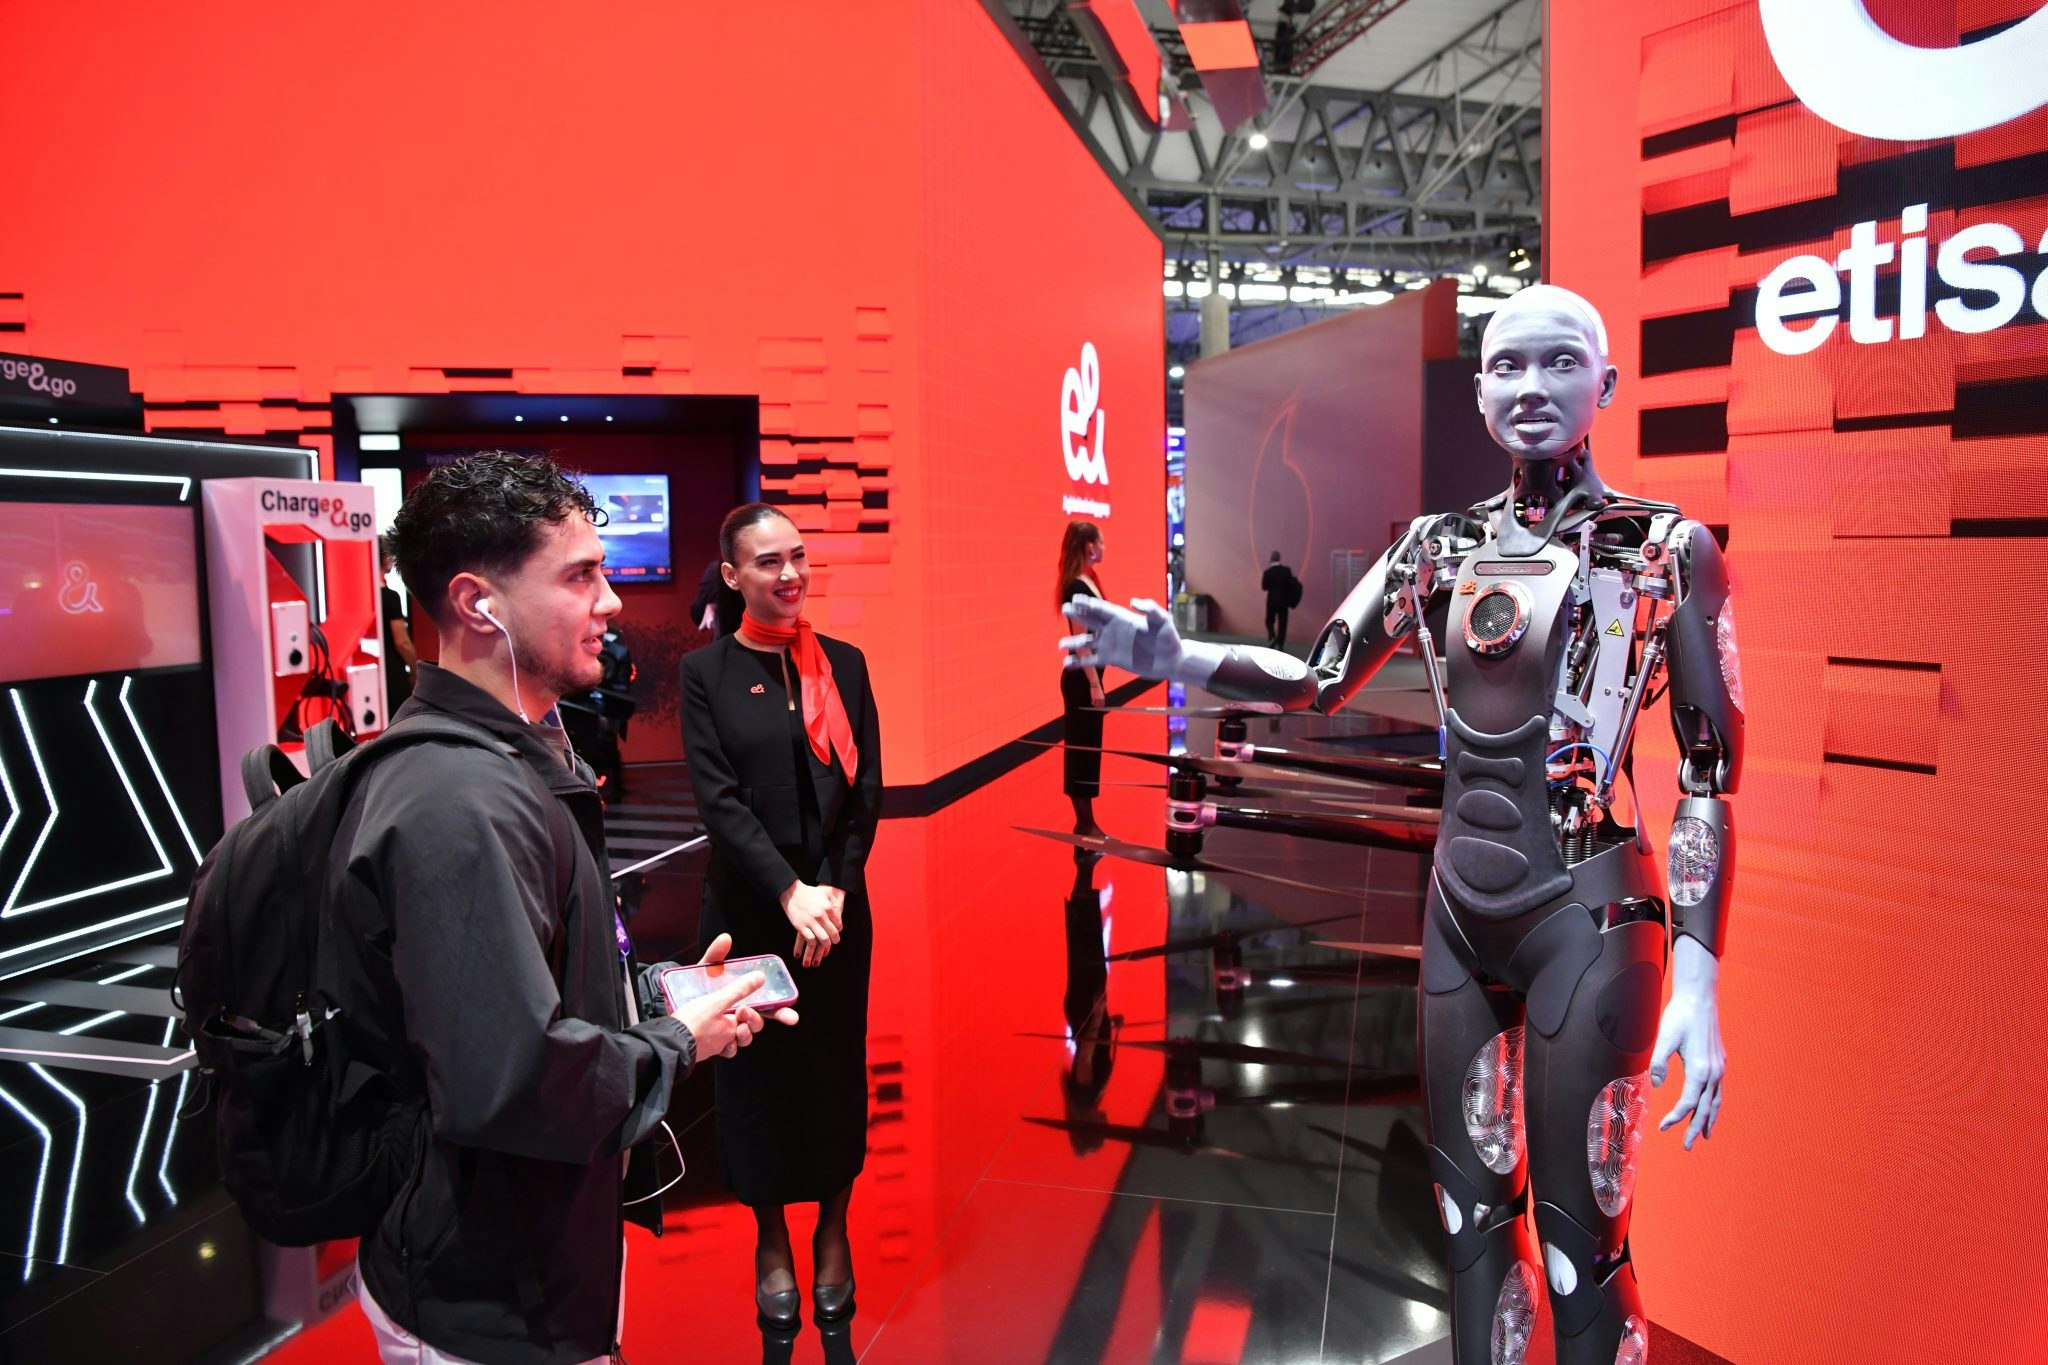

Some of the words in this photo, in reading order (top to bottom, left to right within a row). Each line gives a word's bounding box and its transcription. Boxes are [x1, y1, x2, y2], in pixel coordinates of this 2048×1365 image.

[1755, 203, 2048, 355] etis
[0, 360, 76, 397] ge&go
[261, 489, 372, 532] Charge&go
